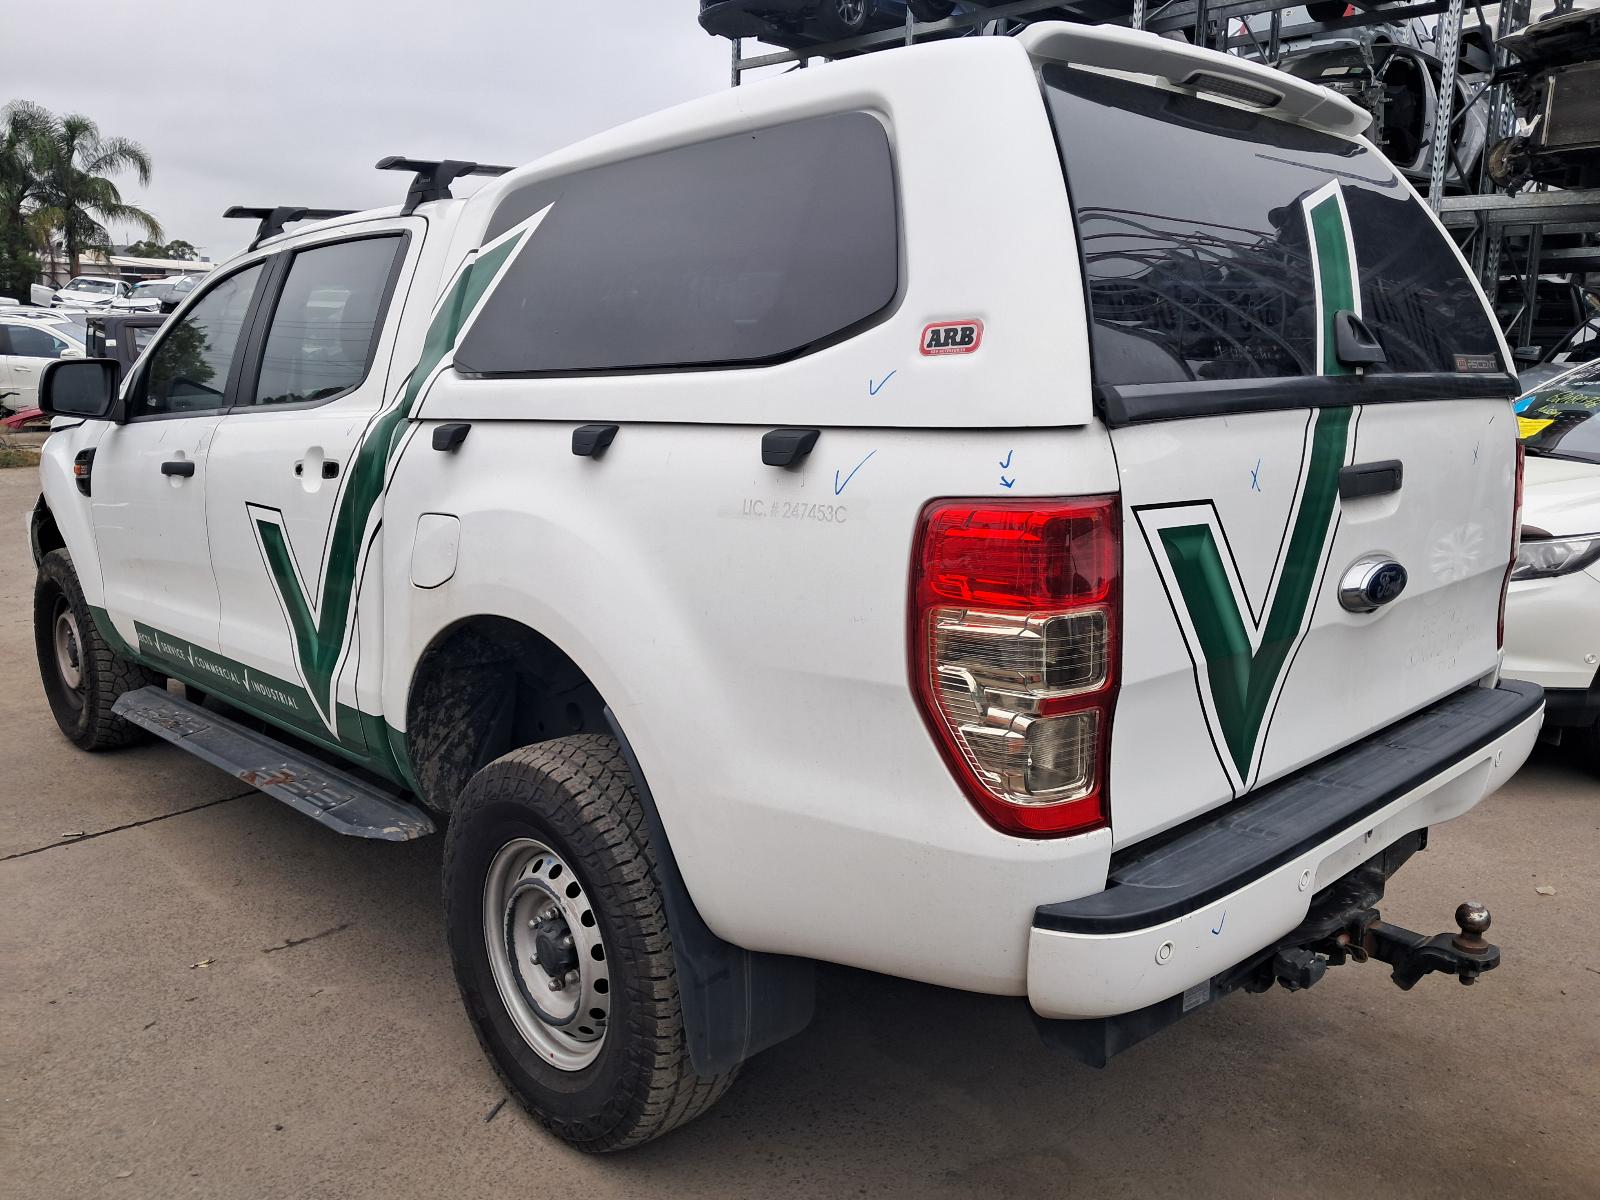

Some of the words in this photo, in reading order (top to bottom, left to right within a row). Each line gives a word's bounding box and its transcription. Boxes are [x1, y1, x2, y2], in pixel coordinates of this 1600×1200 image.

[926, 326, 975, 348] ARB
[743, 499, 767, 517] LIC.
[782, 501, 848, 524] 247453C
[160, 641, 186, 661] SERVICE
[194, 656, 240, 685] COMMERCIAL
[251, 680, 299, 710] INDUSTRIAL
